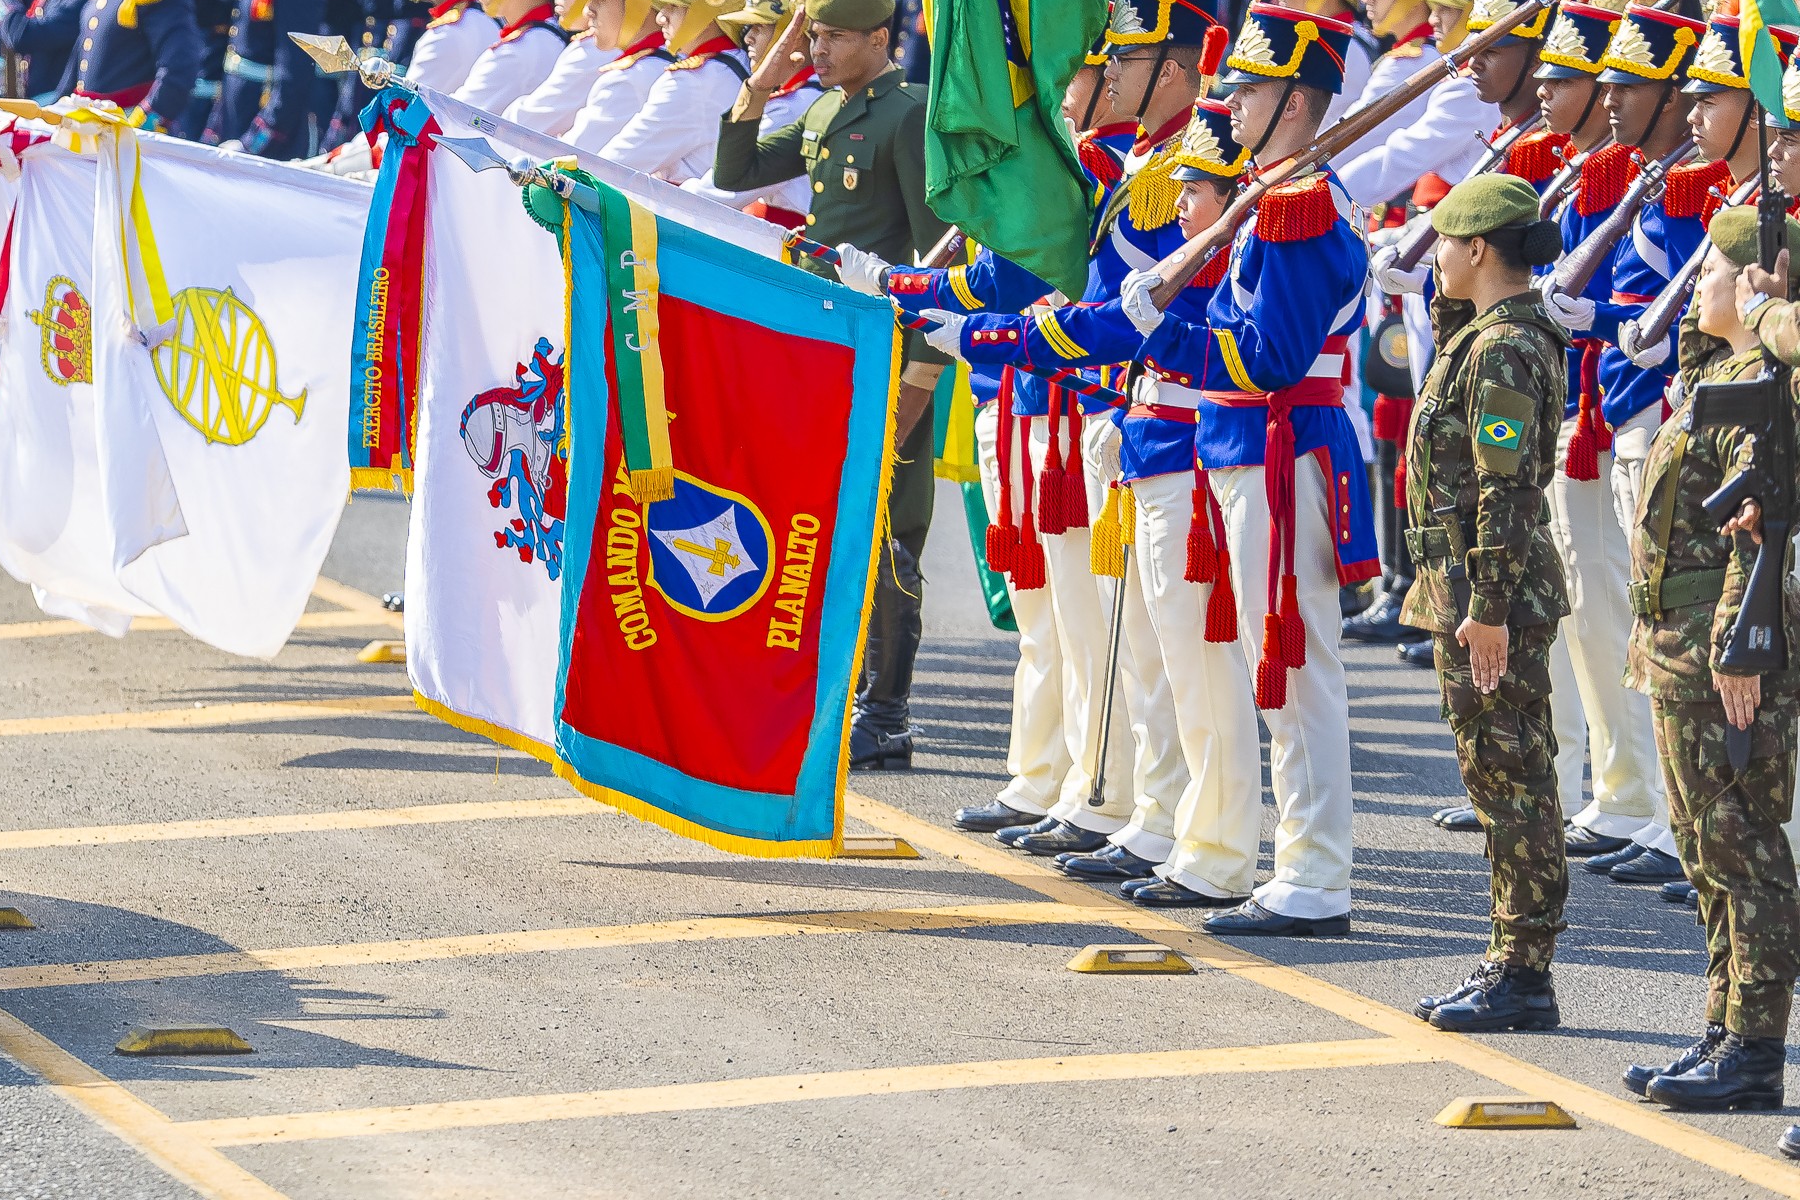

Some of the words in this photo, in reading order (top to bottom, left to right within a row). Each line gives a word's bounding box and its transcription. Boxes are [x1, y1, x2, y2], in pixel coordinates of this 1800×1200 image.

[366, 267, 390, 362] BRASILEIRO
[358, 366, 382, 449] EXÉRCITO
[606, 508, 658, 651] COMANDO
[766, 513, 821, 652] PLANALTO
